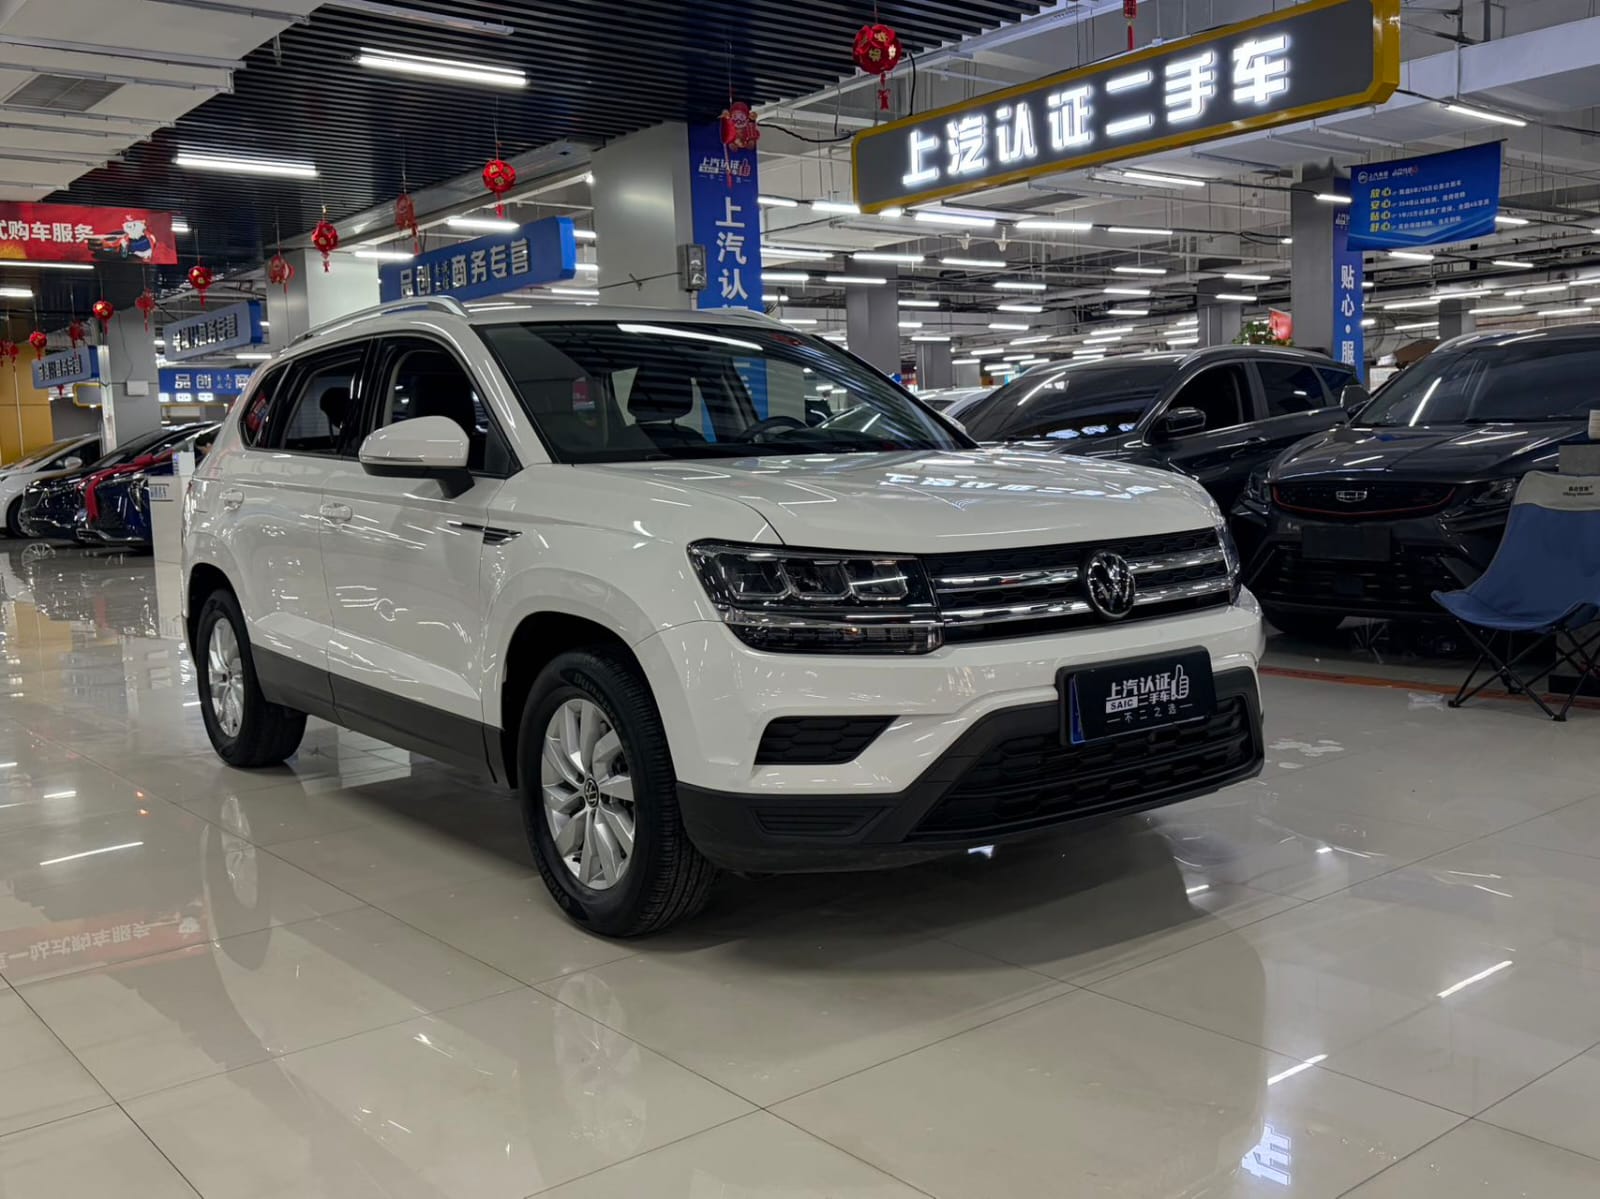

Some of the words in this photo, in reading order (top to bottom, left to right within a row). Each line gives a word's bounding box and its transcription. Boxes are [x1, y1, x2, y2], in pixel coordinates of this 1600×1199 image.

[902, 33, 1291, 187] 上汽认证二手车
[715, 196, 749, 309] 上汽认
[1106, 673, 1171, 700] 上汽认证
[1110, 698, 1133, 711] SAIC
